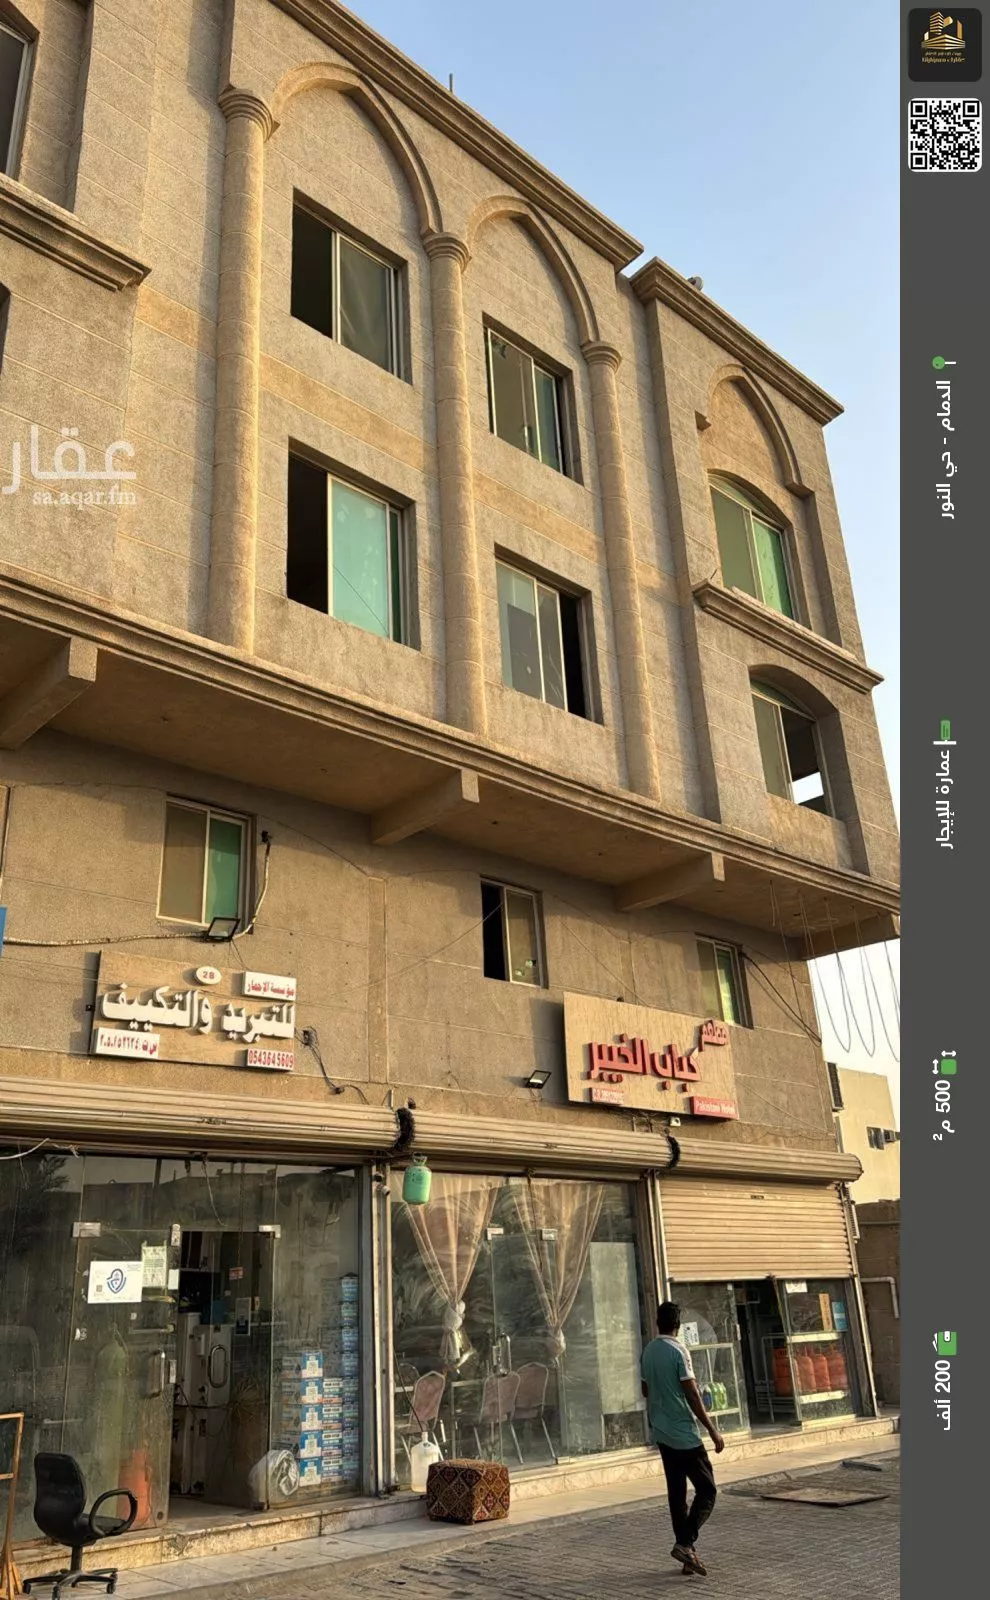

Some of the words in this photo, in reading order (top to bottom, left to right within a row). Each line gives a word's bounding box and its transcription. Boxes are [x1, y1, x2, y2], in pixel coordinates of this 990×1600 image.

[103, 982, 213, 1035] والتكييف
[222, 1003, 295, 1043] للتبريد
[248, 1050, 295, 1068] 0543645609
[587, 1033, 651, 1082] الخبير
[652, 1045, 701, 1092] كباب
